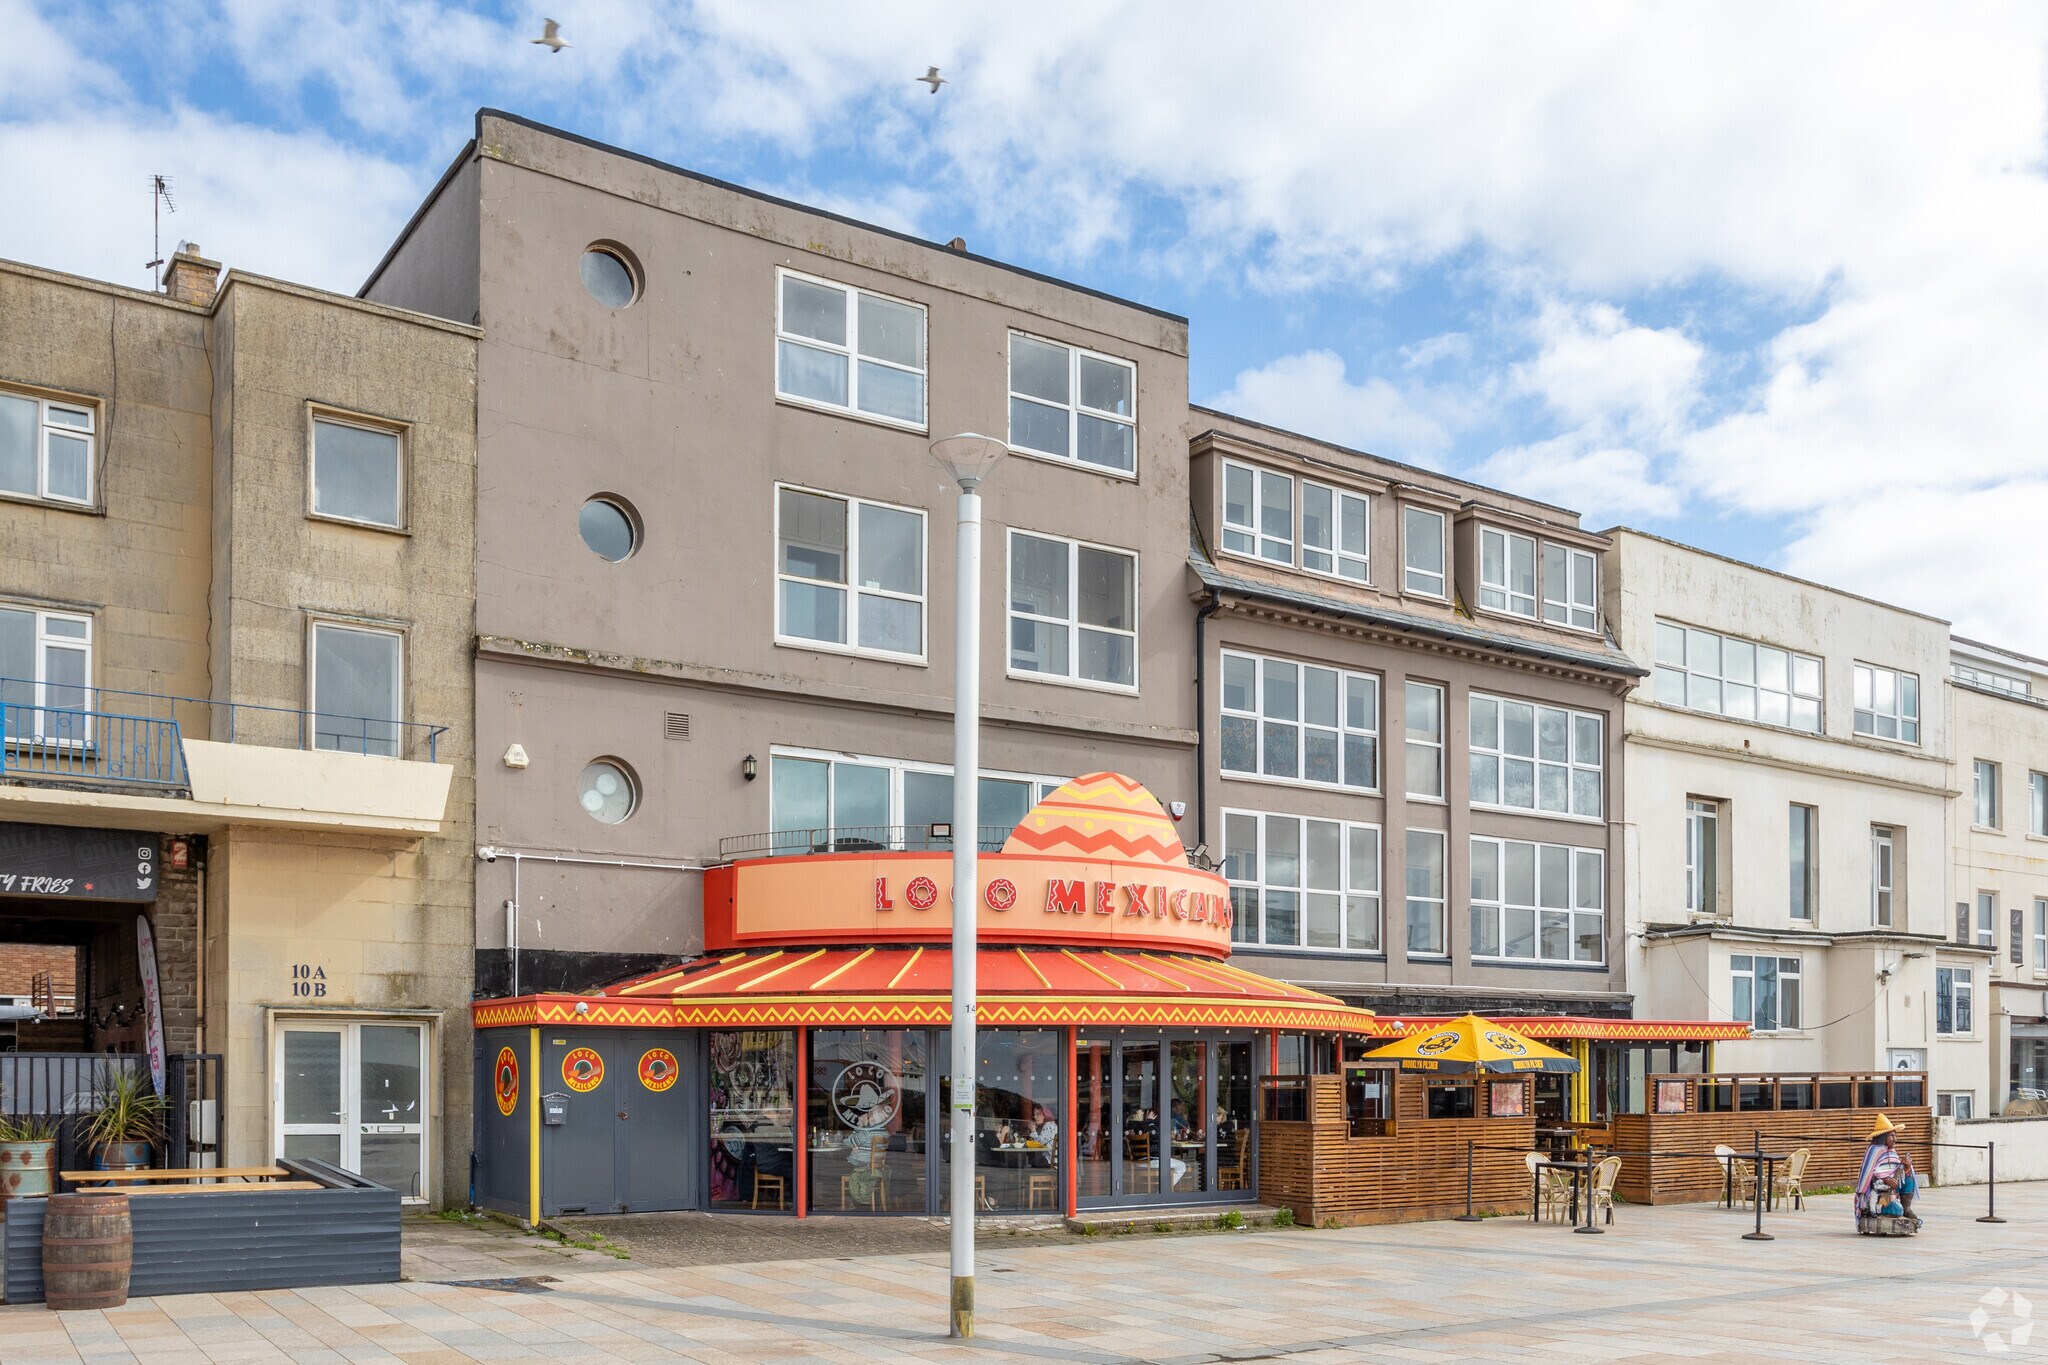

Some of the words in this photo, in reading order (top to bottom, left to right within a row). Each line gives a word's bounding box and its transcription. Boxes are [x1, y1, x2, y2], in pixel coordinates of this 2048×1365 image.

[21, 876, 74, 893] FRIES
[875, 876, 1017, 911] LOO
[1045, 878, 1233, 928] MEXICANO
[501, 1051, 514, 1065] LOCO
[572, 1051, 595, 1060] LOCO
[647, 1051, 670, 1060] LOCO
[847, 1066, 884, 1080] LOCO
[567, 1076, 599, 1090] MEXICANO
[643, 1075, 674, 1090] MEXICANO
[841, 1105, 893, 1128] MEXNO
